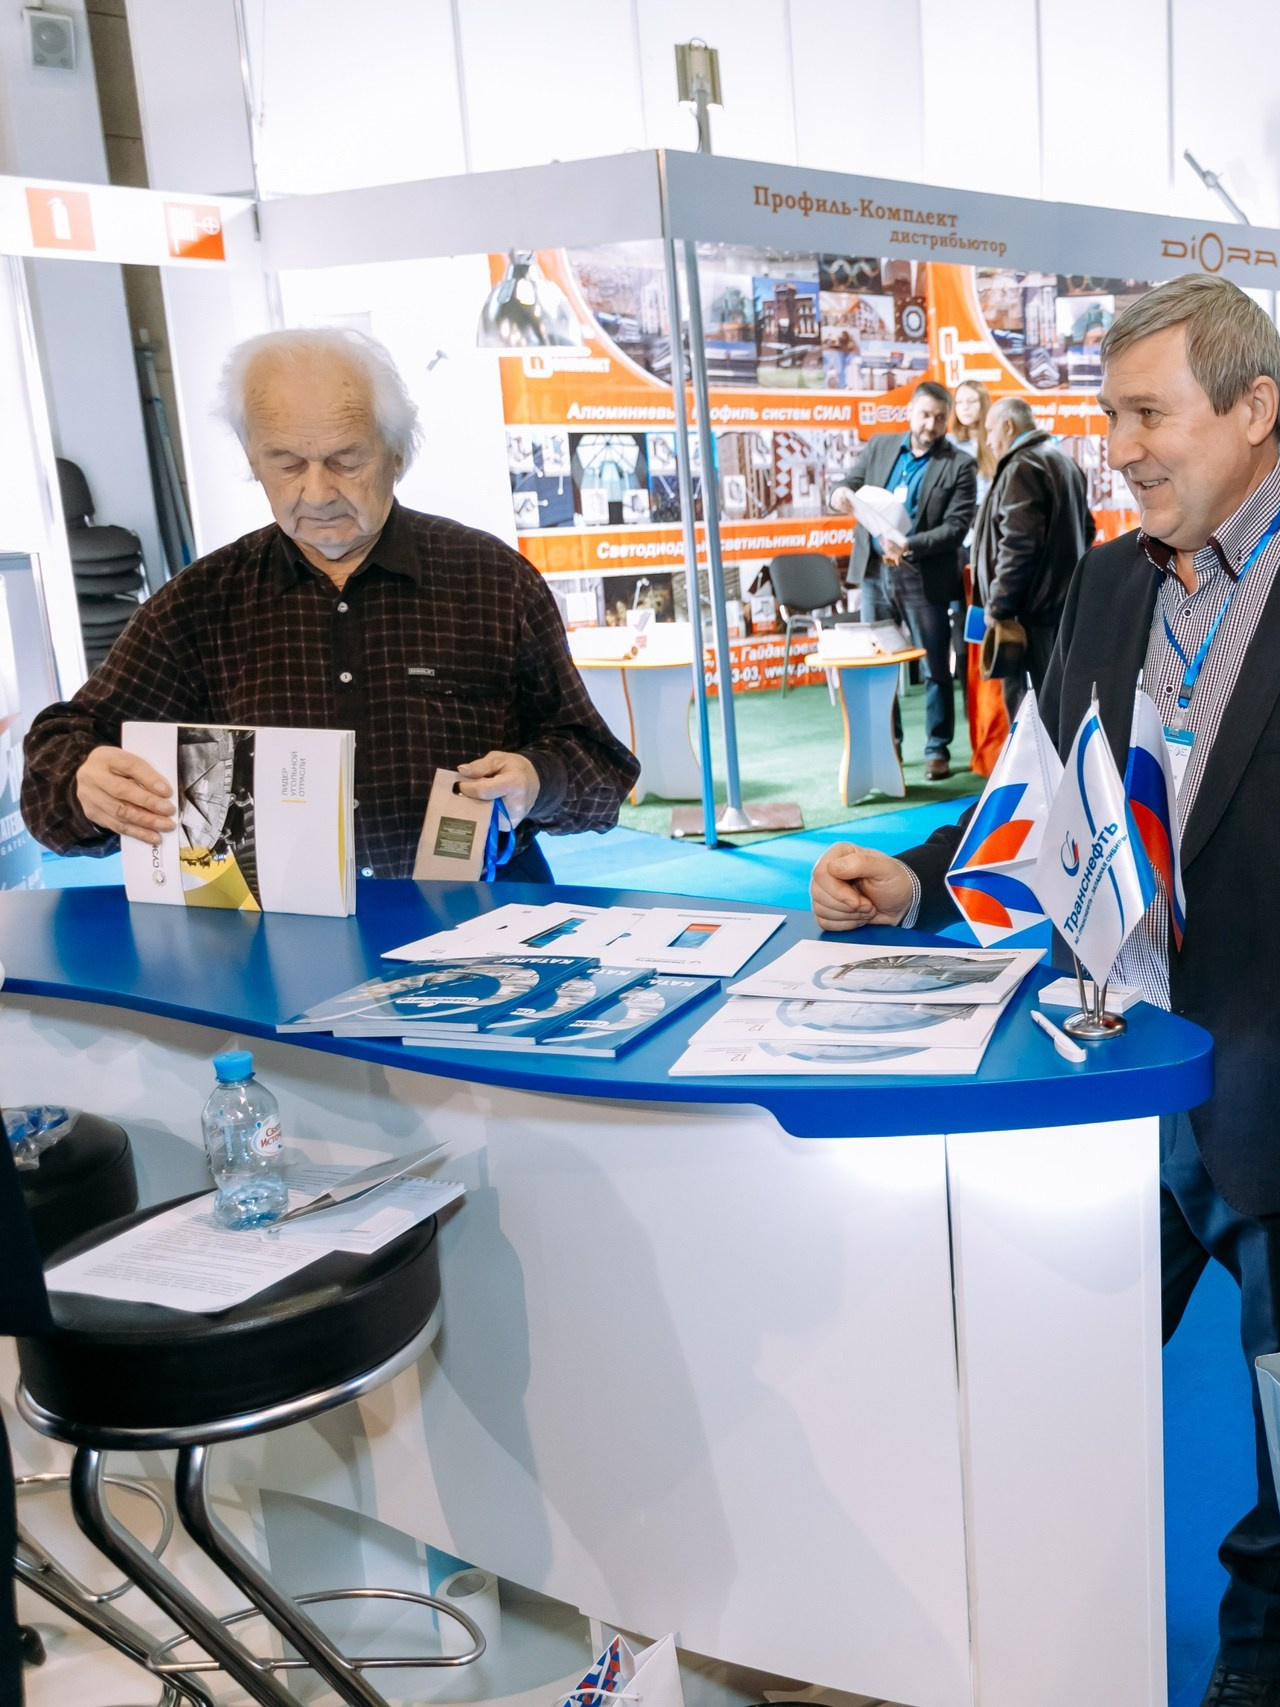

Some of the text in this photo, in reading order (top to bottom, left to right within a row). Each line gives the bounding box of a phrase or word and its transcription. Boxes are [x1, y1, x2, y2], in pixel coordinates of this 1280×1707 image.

[753, 185, 959, 228] Профиль-Комплект
[890, 230, 1008, 256] дистрибьютор
[813, 405, 852, 421] СИАЛ
[1063, 821, 1119, 933] Транснефть
[730, 1053, 747, 1062] 12
